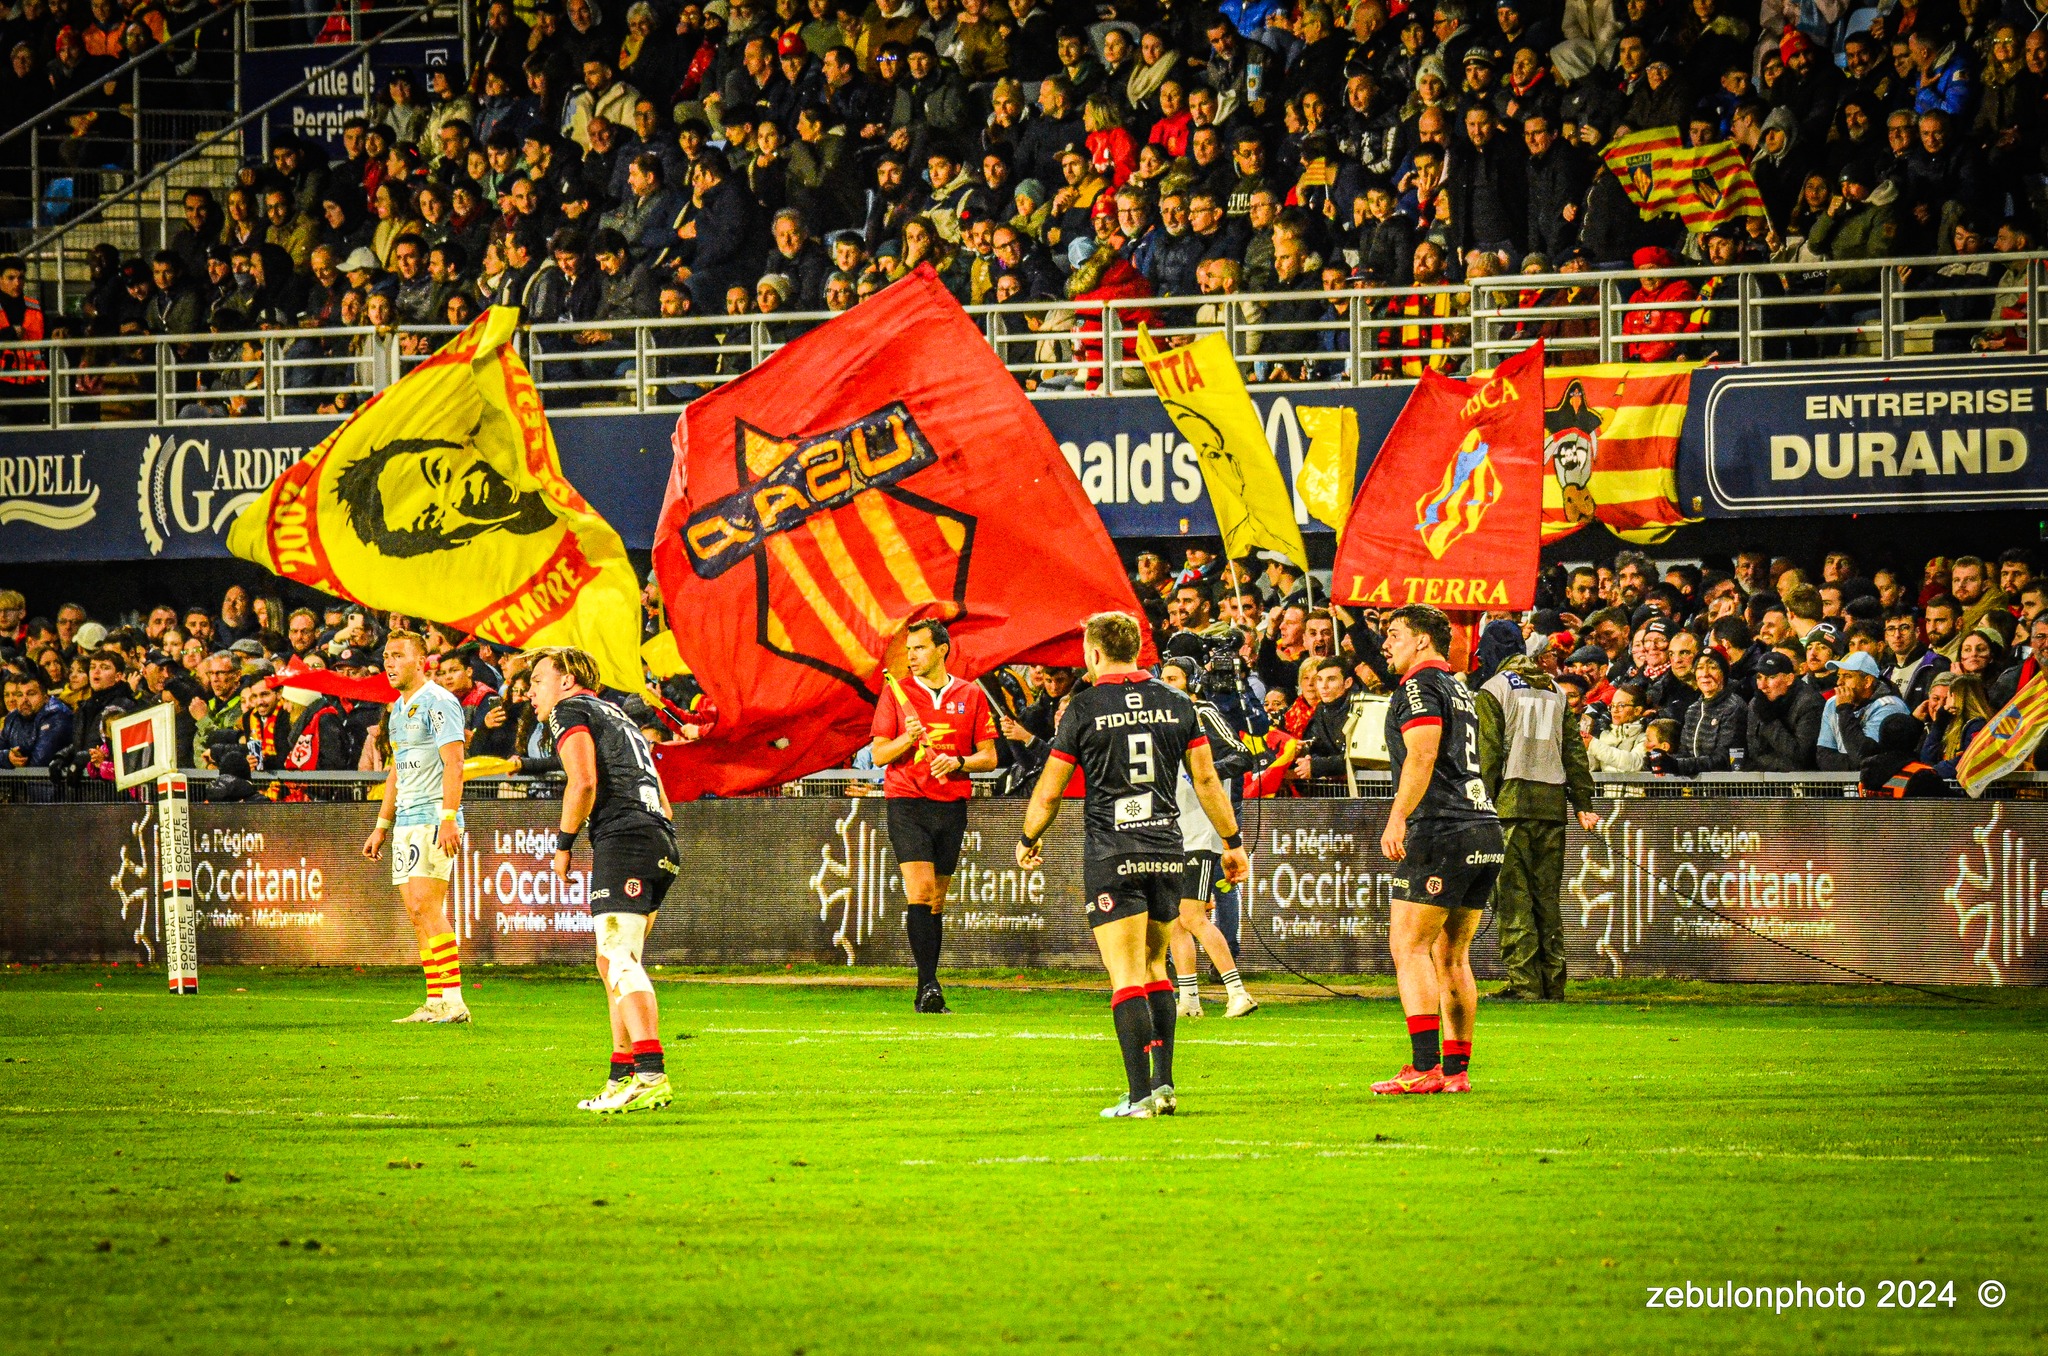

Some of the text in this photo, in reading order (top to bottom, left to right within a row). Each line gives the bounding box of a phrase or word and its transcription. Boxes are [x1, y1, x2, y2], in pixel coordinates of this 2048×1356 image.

[304, 64, 348, 96] Ville
[293, 103, 372, 142] Perpi
[1145, 350, 1205, 398] TTA
[1806, 388, 2034, 420] ENTREPRISE
[1770, 428, 2028, 481] DURAND
[1348, 575, 1509, 605] LA TERRA
[1405, 678, 1428, 715] actual
[1094, 708, 1180, 731] FIDUCIAL
[622, 726, 658, 780] 13
[1127, 732, 1155, 785] 9
[1465, 722, 1480, 774] 2
[173, 818, 183, 872] SOCIETE
[180, 806, 191, 873] GENERALE
[194, 827, 264, 858] La Région
[494, 829, 512, 853] La
[1272, 828, 1355, 860] La Région
[1673, 825, 1761, 859] La Région
[194, 857, 322, 901] Occitanie
[1117, 859, 1183, 875] chausson
[1673, 860, 1834, 909] Occitanie
[178, 915, 189, 970] SOCIETE
[185, 903, 197, 971] GENERALE
